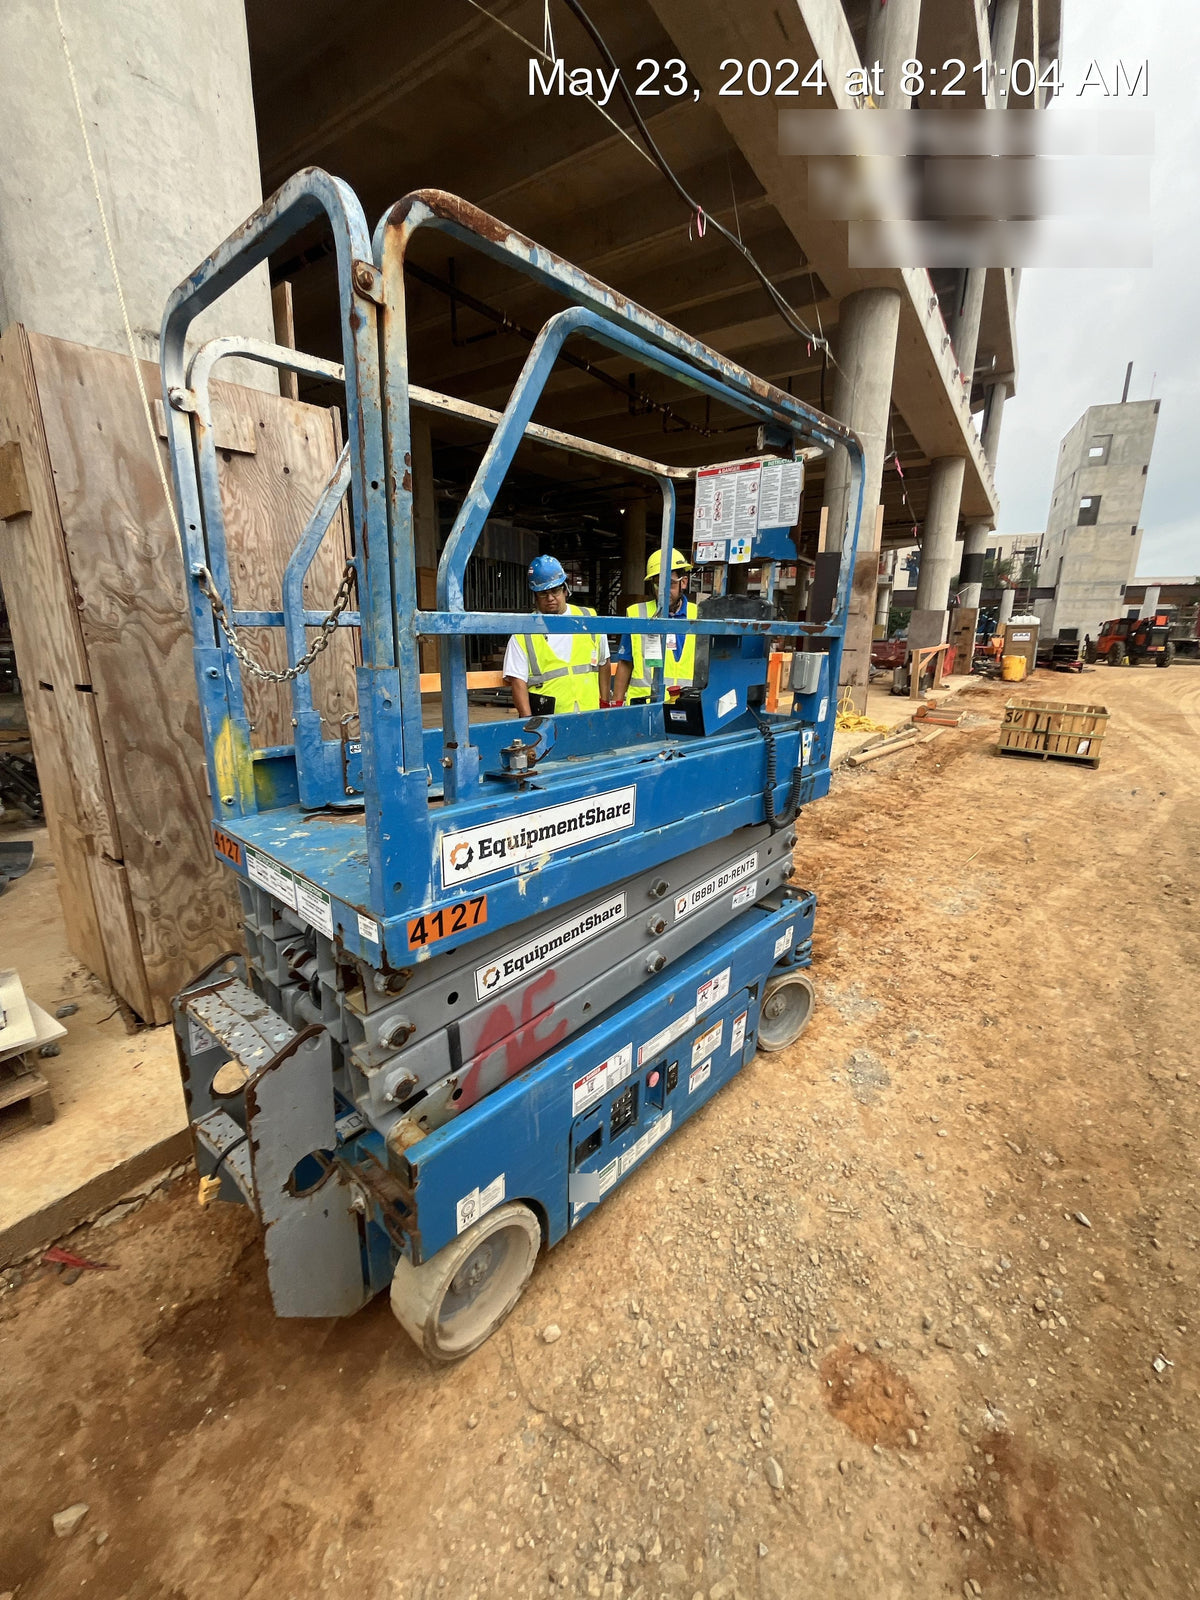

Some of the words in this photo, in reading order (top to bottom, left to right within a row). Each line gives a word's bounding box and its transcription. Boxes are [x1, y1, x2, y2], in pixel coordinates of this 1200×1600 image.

[214, 829, 241, 864] 4127
[478, 801, 631, 861] EquipmentShare
[692, 881, 716, 905] (888)
[717, 858, 755, 888] 80-RENTS
[409, 896, 486, 946] 4127
[502, 903, 622, 977] EquipmentShare
